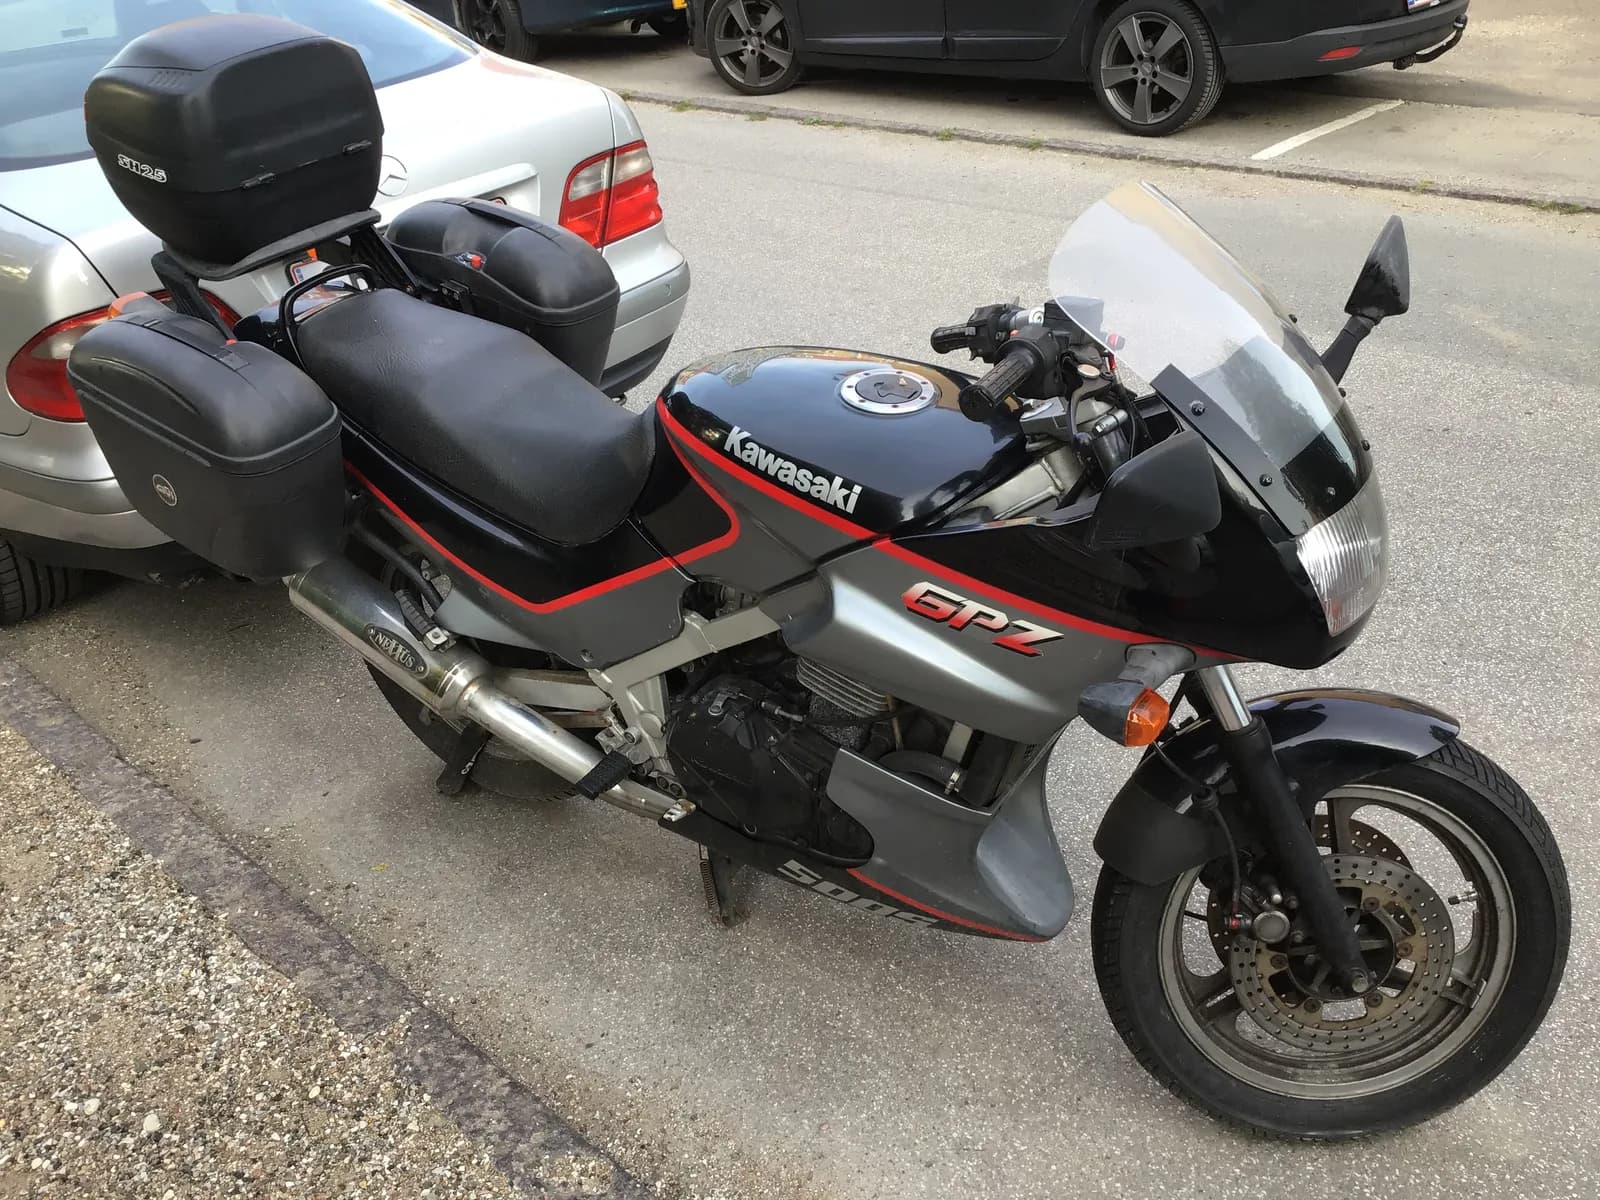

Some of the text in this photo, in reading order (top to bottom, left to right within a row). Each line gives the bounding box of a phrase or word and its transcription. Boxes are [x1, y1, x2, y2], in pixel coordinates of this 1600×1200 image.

[117, 154, 167, 183] SH25
[723, 425, 863, 514] Kawasaki
[902, 581, 1064, 656] GPZ
